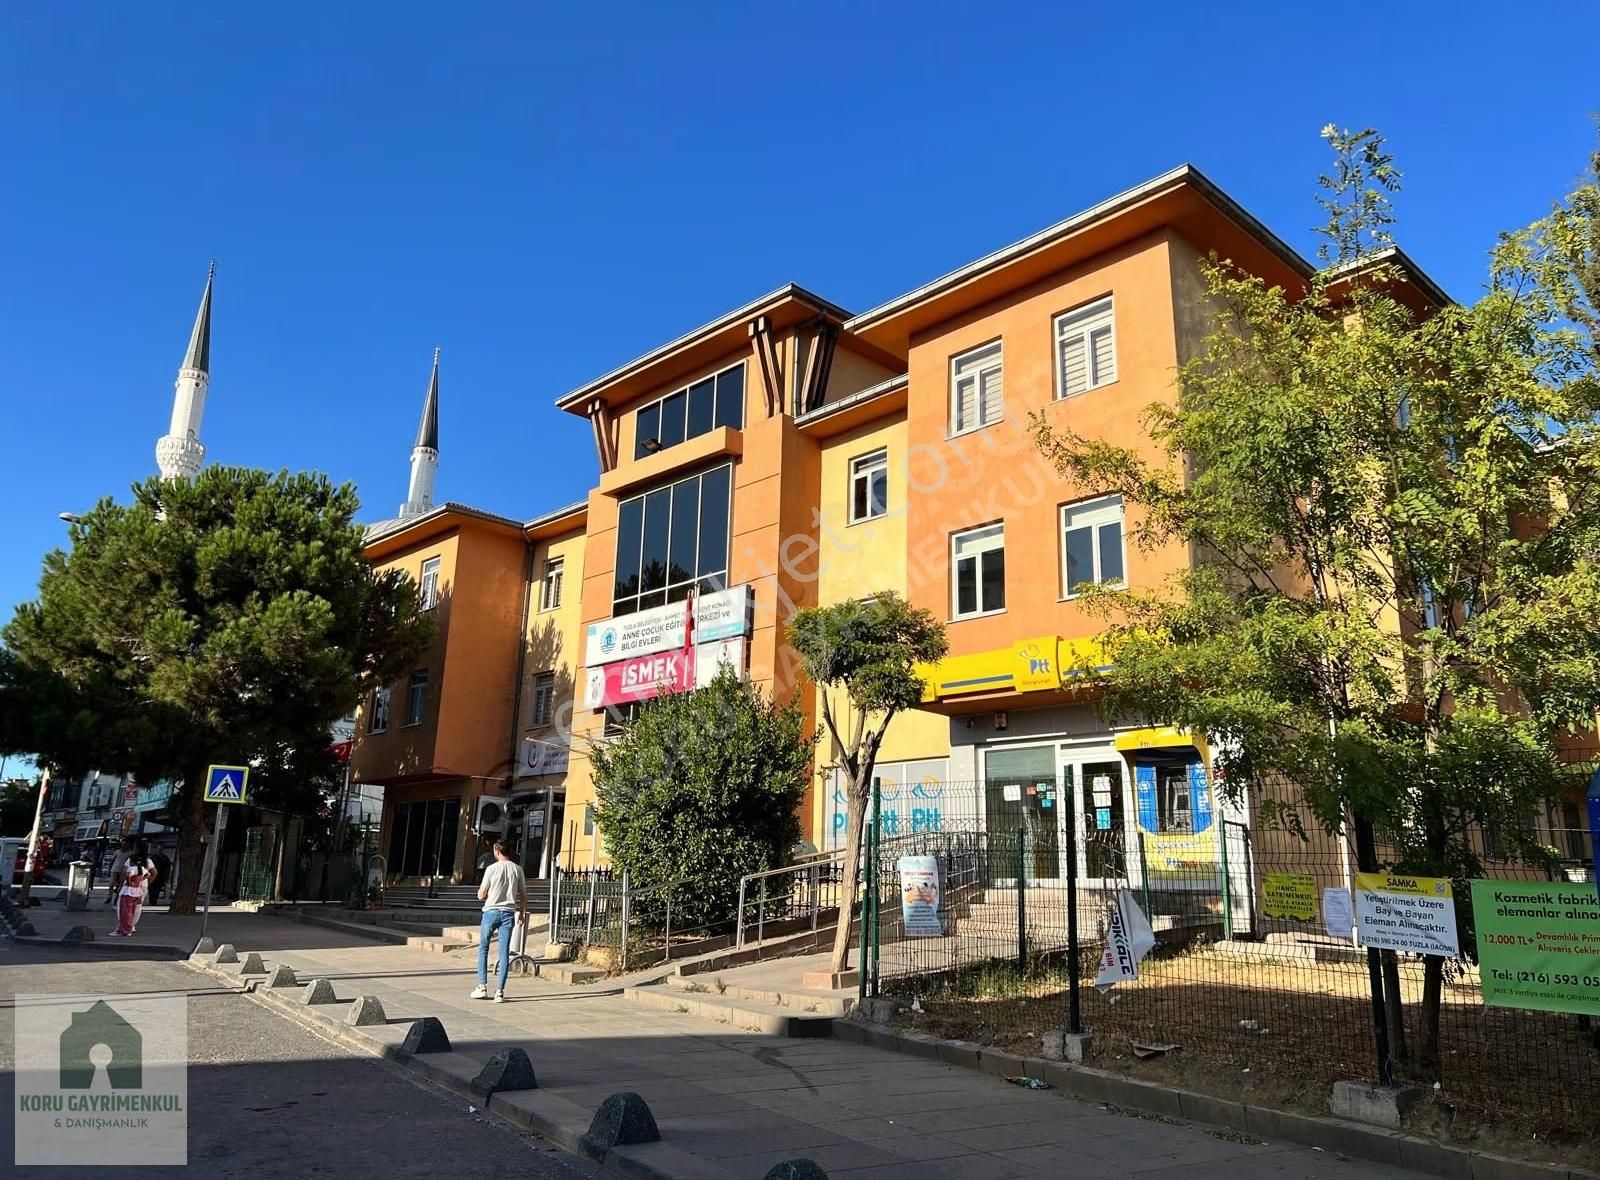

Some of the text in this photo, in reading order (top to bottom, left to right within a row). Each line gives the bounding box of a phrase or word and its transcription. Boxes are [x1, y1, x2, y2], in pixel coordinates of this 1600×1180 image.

[722, 610, 731, 618] ve
[622, 631, 640, 640] ANNE
[621, 636, 661, 651] BİLGİ EVLERİ
[622, 656, 678, 686] İSMEK
[1386, 878, 1417, 888] SAMKA
[1364, 894, 1444, 909] Yetiştirilmek Üzere
[1495, 892, 1600, 905] Kozmetik fabrik
[1376, 906, 1391, 916] Bay
[1405, 910, 1433, 920] Bayan
[1497, 906, 1561, 918] elemanlar
[1365, 916, 1447, 933] Eleman Alınacaktır.
[1409, 941, 1428, 949] TUZLA
[1491, 970, 1512, 980] Tel:
[1518, 972, 1550, 985] (216)
[1554, 975, 1578, 985] 593
